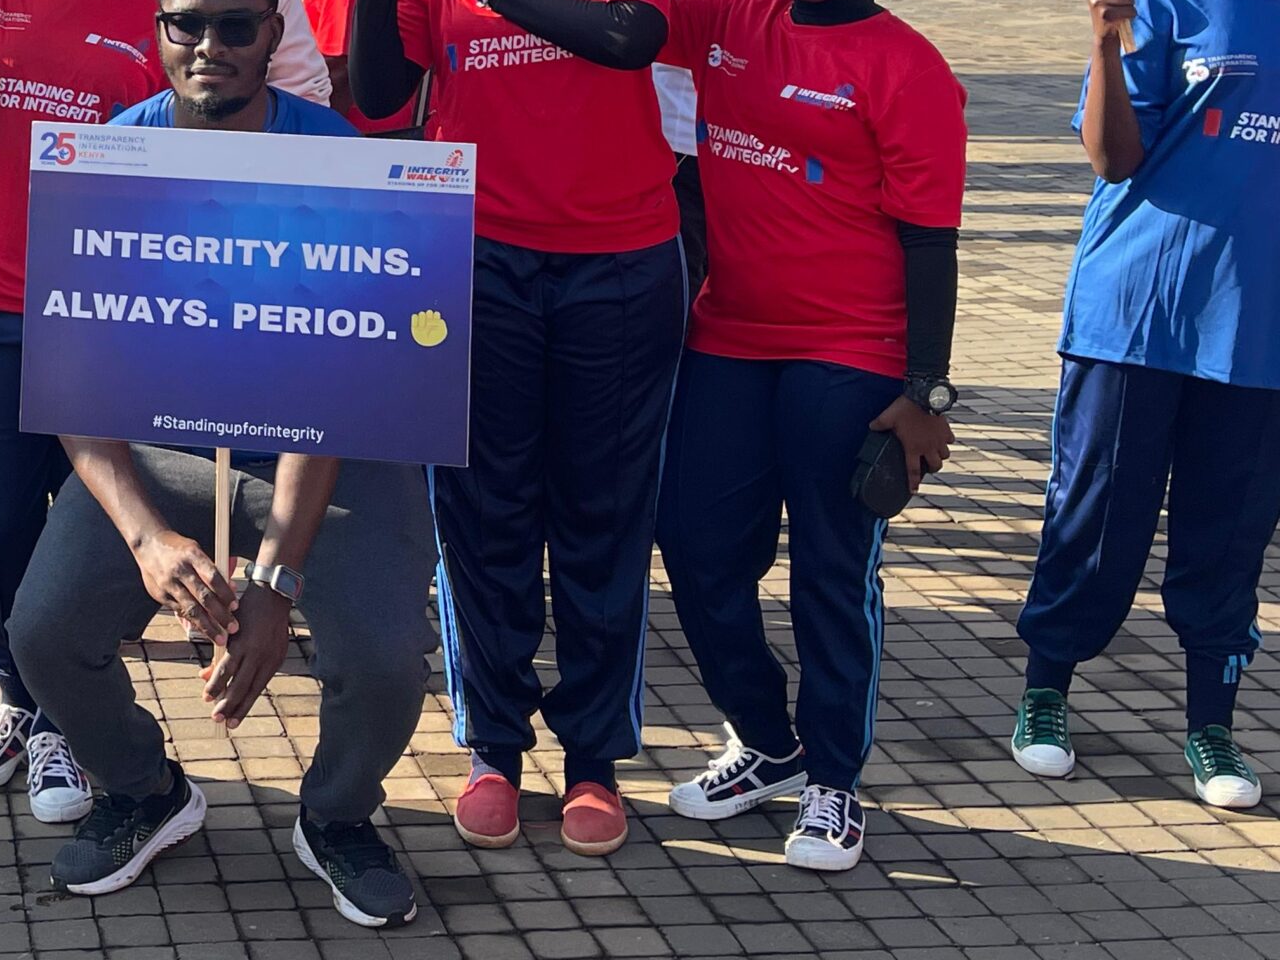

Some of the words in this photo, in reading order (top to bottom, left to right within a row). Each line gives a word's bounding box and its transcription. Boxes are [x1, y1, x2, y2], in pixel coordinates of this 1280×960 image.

[103, 38, 148, 64] INTEGRITY
[464, 53, 499, 71] FOR
[503, 46, 574, 66] INTEGR
[22, 97, 103, 123] INTEGRITY
[77, 92, 100, 107] UP
[797, 88, 856, 108] INTEGRITY
[79, 133, 145, 143] TRANSPARENCY
[706, 123, 764, 150] STANDING
[769, 145, 791, 161] UP
[1230, 125, 1268, 142] FOR
[39, 132, 76, 165] 25
[79, 142, 148, 152] INTERNATIONAL
[722, 145, 799, 173] INTEGRITY
[407, 166, 469, 176] INTEGRITY
[73, 229, 289, 268] INTEGRITY
[302, 243, 421, 277] WINS.
[42, 290, 218, 329] ALWAYS.
[232, 302, 398, 340] PERIOD.
[153, 414, 325, 444] #Standingupforintegrity
